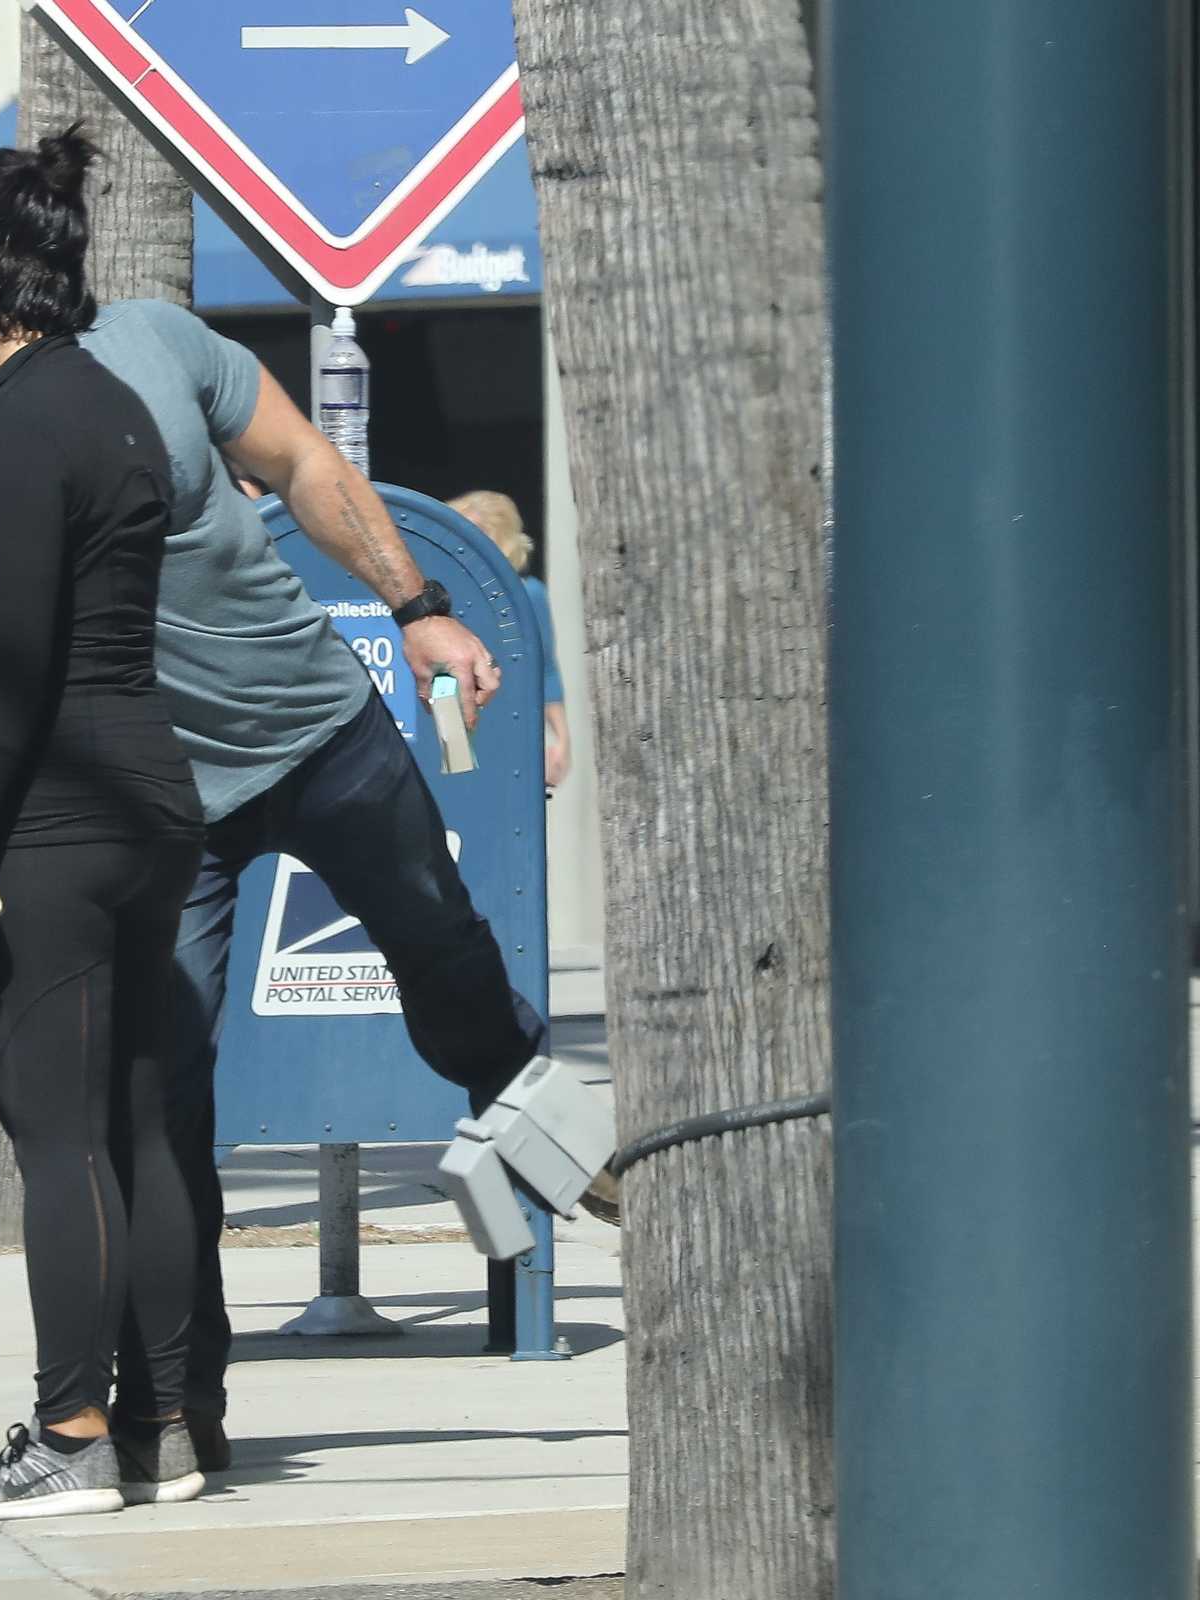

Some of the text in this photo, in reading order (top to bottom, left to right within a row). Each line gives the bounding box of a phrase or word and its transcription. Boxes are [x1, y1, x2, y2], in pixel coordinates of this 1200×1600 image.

[437, 243, 529, 292] Budget
[321, 602, 392, 617] ollectio
[352, 637, 394, 668] 30
[368, 669, 394, 694] M
[270, 965, 390, 982] UNITED STAT
[266, 985, 400, 1002] POSTAL SERVI
